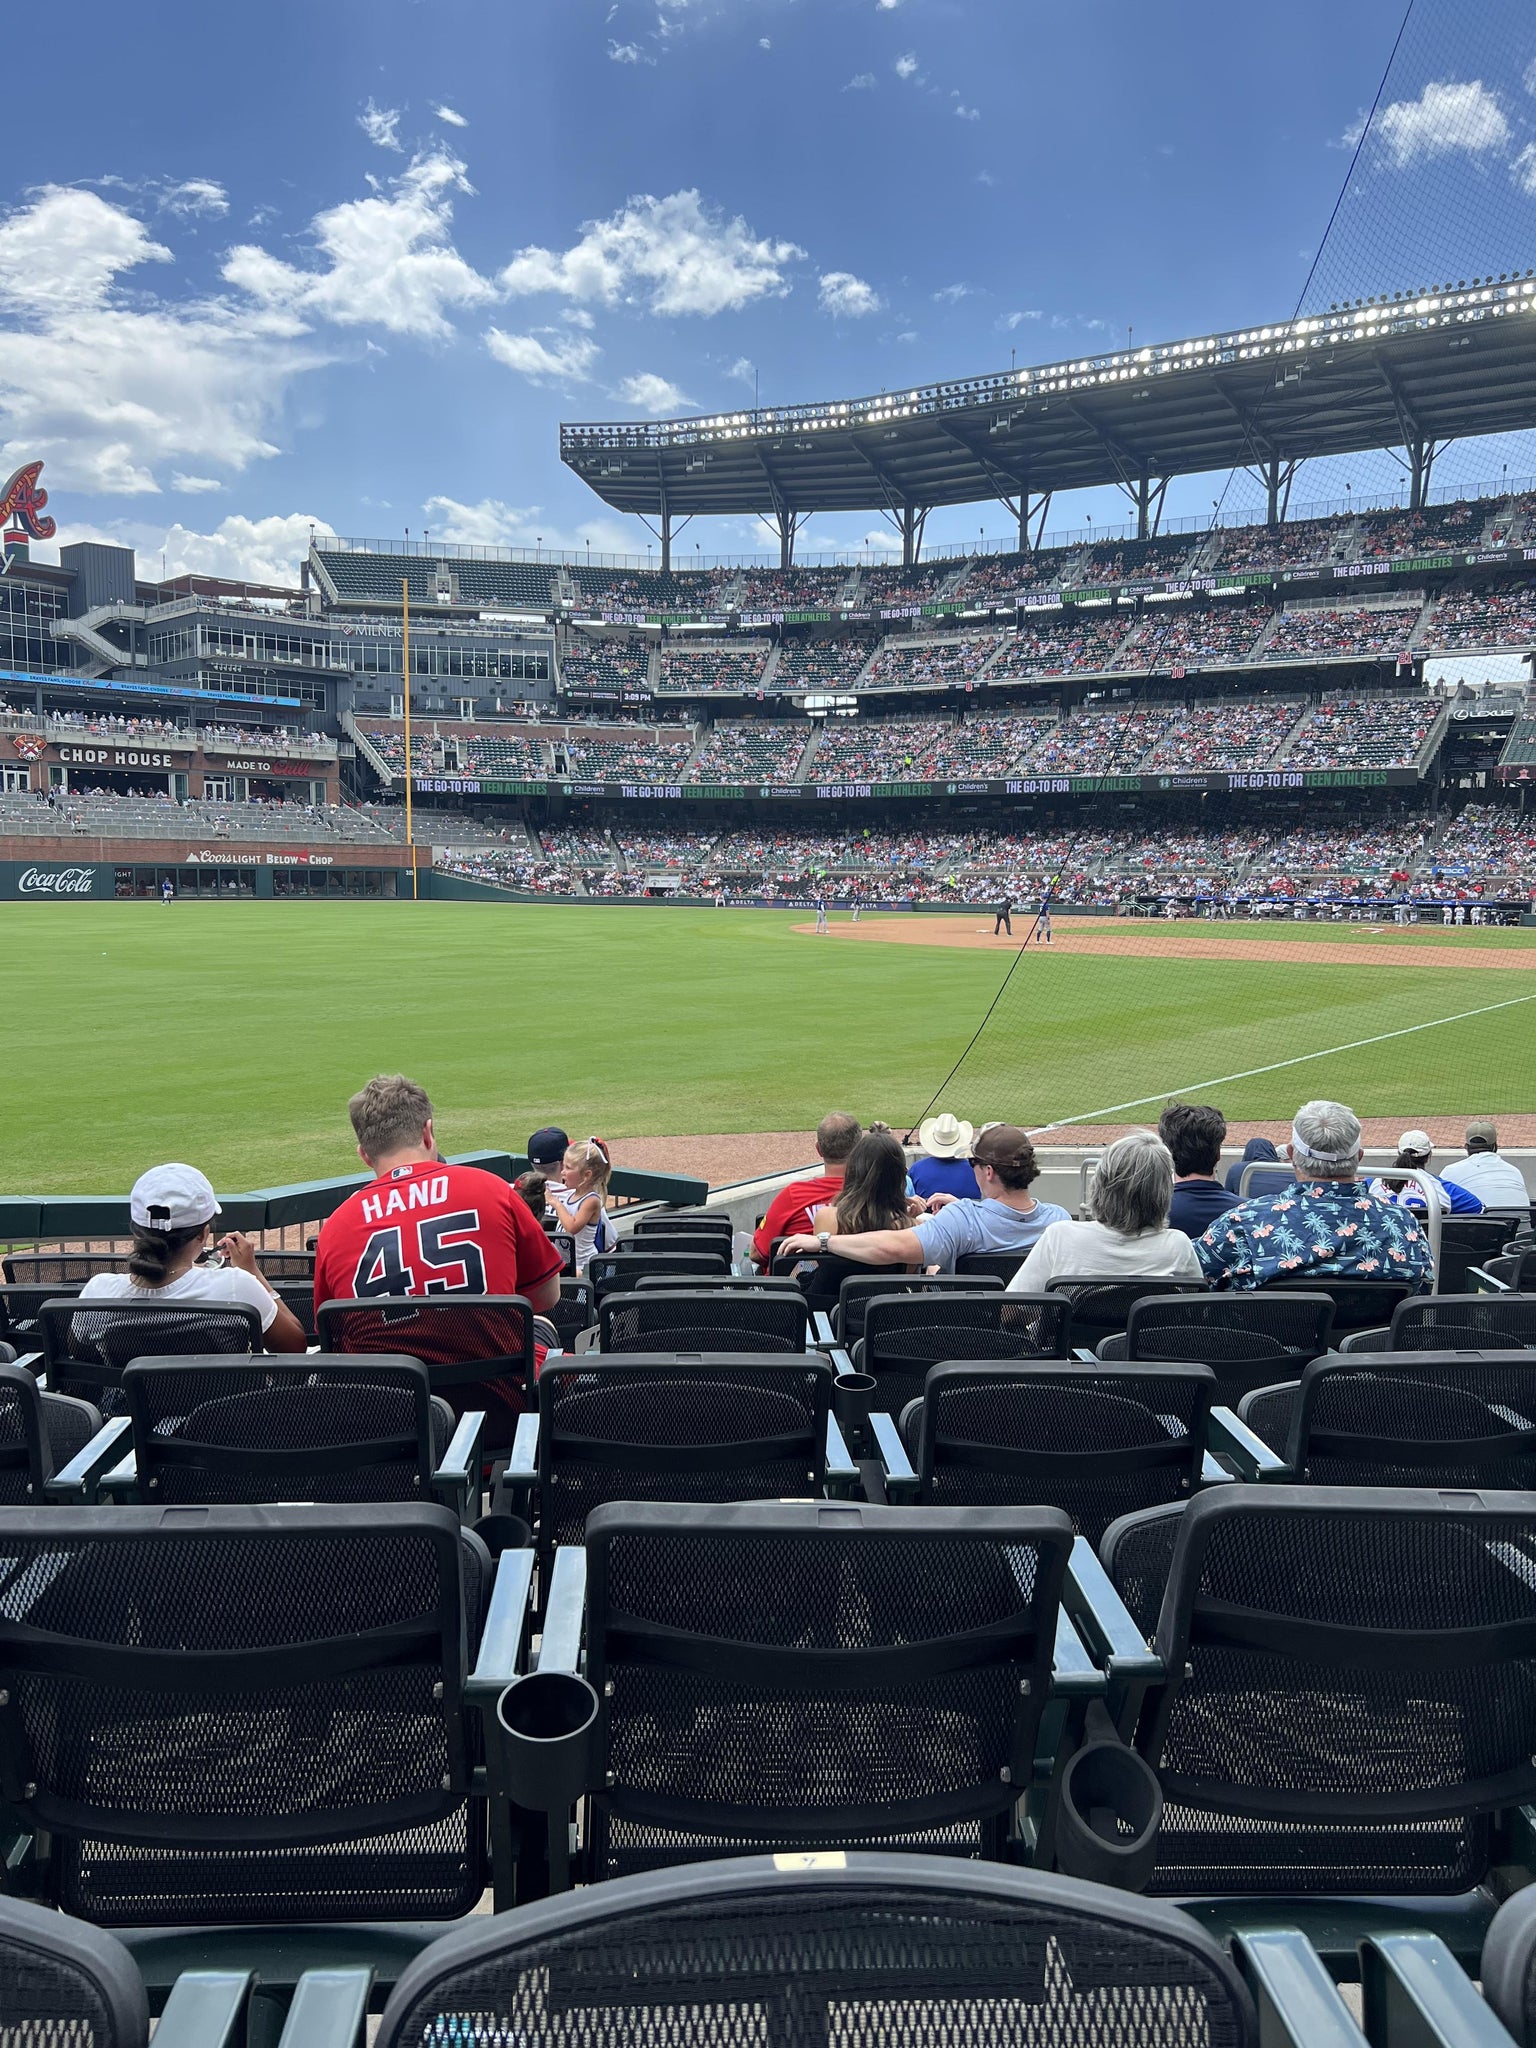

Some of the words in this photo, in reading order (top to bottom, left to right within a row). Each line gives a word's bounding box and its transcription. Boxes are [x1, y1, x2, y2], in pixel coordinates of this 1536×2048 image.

[1477, 553, 1508, 561] Children's
[1333, 567, 1348, 578] THE
[1349, 565, 1372, 576] GO-TO
[1374, 563, 1389, 574] FOR
[1391, 561, 1410, 572] TEEN
[1412, 557, 1452, 570] ATHLETES
[1165, 583, 1178, 592] THE
[1202, 579, 1215, 589] FOR
[1217, 577, 1235, 588] TEEN
[1235, 574, 1271, 586] ATHLETES
[1015, 597, 1027, 606] THE
[1028, 595, 1047, 605] GO-TO
[1048, 594, 1060, 603] FOR
[1061, 592, 1077, 602] TEEN
[1078, 589, 1110, 601] ATHLETES
[601, 613, 613, 622] THE
[614, 613, 632, 622] GO-TO
[633, 614, 645, 623] FOR
[647, 614, 661, 623] TEEN
[662, 614, 691, 623] ATHLETES
[740, 614, 751, 622] THE
[752, 614, 771, 622] GO-TO
[772, 613, 784, 622] FOR
[785, 613, 800, 622] TEEN
[801, 612, 831, 621] ATHLETES
[880, 610, 891, 619] THE
[892, 608, 909, 617] GO-TO
[910, 607, 921, 616] FOR
[922, 605, 936, 615] TEEN
[937, 603, 965, 614] ATHLETES
[355, 625, 402, 637] MILNER
[1398, 651, 1412, 664] 21
[1171, 666, 1185, 678] 10
[1470, 710, 1514, 718] LEXUS
[60, 748, 108, 763] CHOP
[115, 751, 172, 767] HOUSE
[227, 760, 255, 770] MADE
[258, 763, 271, 771] TO
[416, 779, 433, 791] THE
[435, 780, 462, 792] GO-TO
[463, 781, 480, 793] FOR
[482, 782, 504, 794] TEEN
[505, 783, 547, 795] ATHLETES
[1005, 781, 1022, 793] THE
[1023, 780, 1049, 793] GO-TO
[1051, 779, 1069, 792] FOR
[1071, 779, 1093, 792] TEEN
[1094, 777, 1141, 791] ATHLETES
[1228, 775, 1248, 788] THE
[1250, 774, 1280, 788] GO-TO
[1283, 773, 1304, 787] FOR
[1305, 773, 1332, 786] TEEN
[1334, 771, 1387, 785] ATHLETES
[621, 786, 637, 797] THE
[639, 786, 665, 798] GO-TO
[665, 786, 681, 798] FOR
[683, 787, 702, 798] TEEN
[704, 787, 744, 798] ATHLETES
[816, 786, 831, 798] THE
[831, 786, 855, 797] GO-TO
[856, 785, 871, 797] FOR
[872, 785, 891, 797] TEEN
[892, 784, 932, 796] ATHLETES
[200, 850, 232, 863] Coors
[232, 855, 261, 863] LIGHT
[266, 854, 298, 864] BELOW
[309, 854, 333, 865] CHOP
[18, 867, 96, 893] Coca-Cola
[361, 1175, 449, 1224] HAND
[352, 1209, 488, 1299] 45
